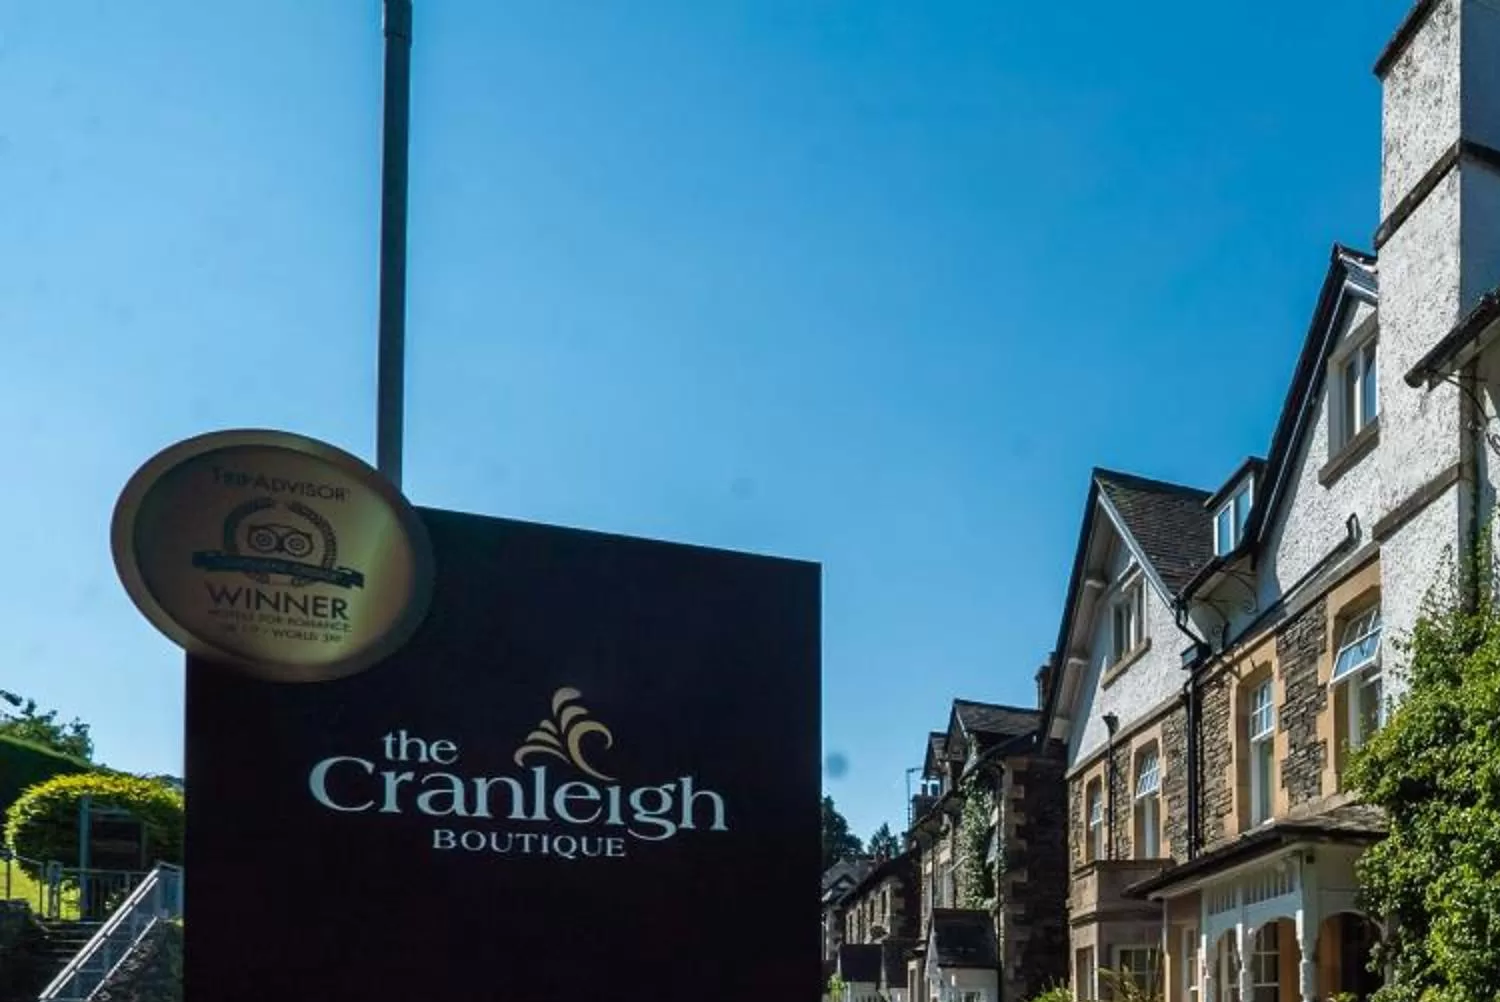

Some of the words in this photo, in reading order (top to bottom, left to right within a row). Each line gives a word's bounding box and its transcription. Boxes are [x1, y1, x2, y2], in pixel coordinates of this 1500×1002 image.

[204, 580, 350, 621] WINNER
[382, 730, 459, 764] the
[309, 756, 728, 841] Cranleigh
[432, 829, 626, 859] BOUTIQUE
